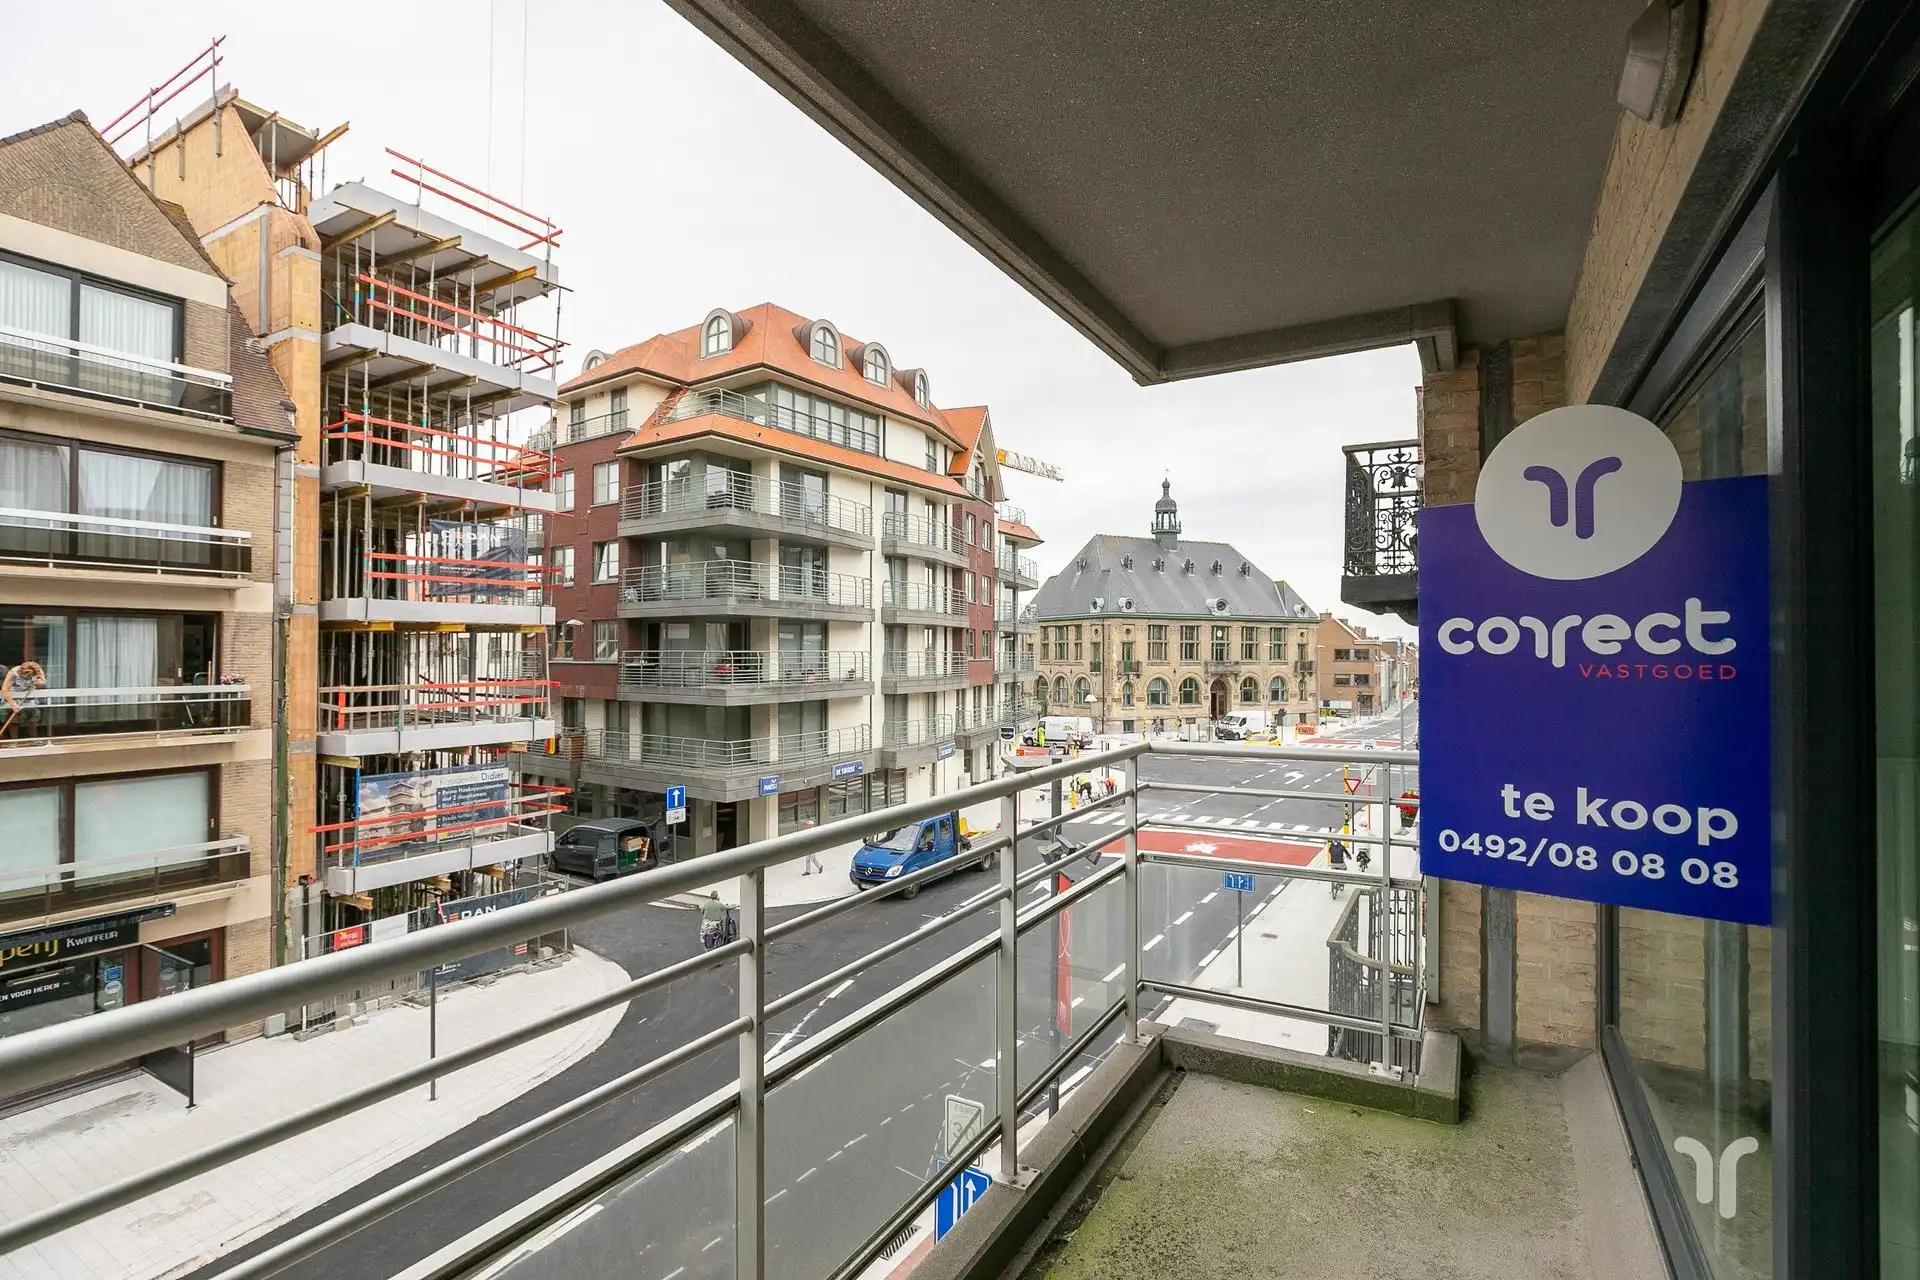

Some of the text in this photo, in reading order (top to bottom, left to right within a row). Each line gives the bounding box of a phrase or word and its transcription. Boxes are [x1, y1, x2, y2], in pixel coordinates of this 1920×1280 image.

[1438, 597, 1738, 668] correct
[1579, 663, 1738, 680] VASTGOED
[481, 769, 504, 780] Didier
[1500, 783, 1739, 846] te koop
[1438, 828, 1739, 889] 0492/08 08 08
[33, 982, 60, 994] HEREN
